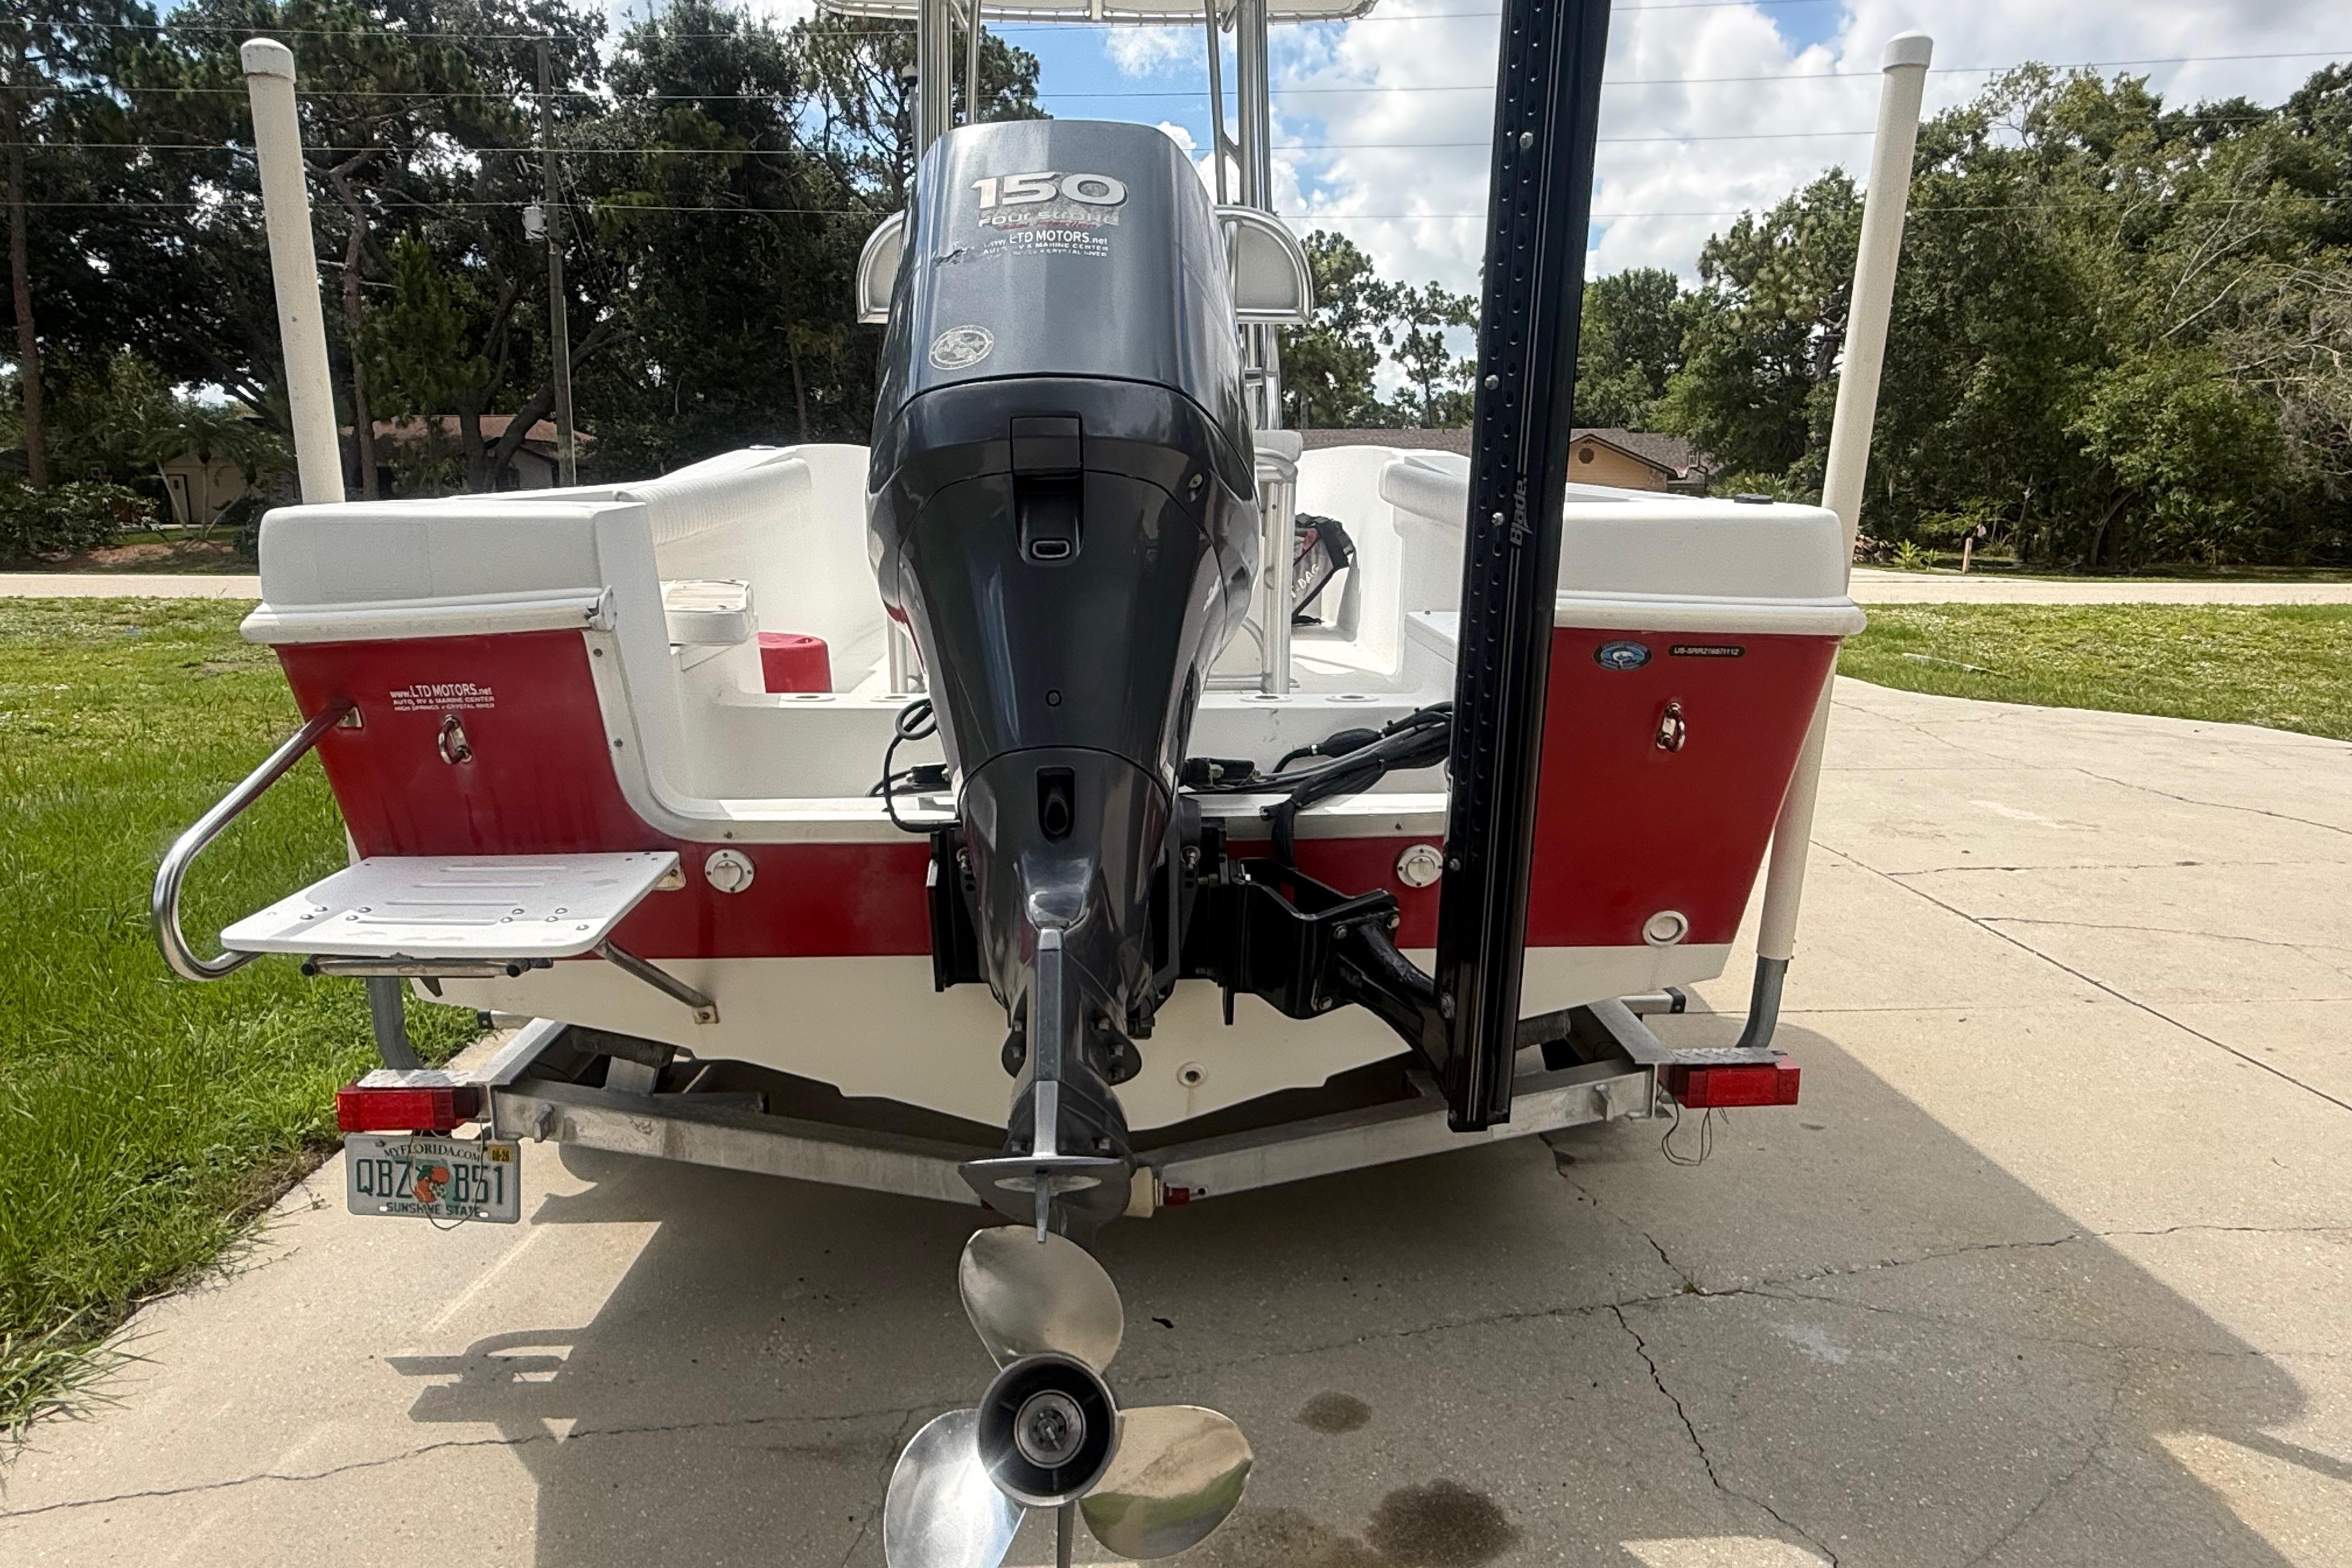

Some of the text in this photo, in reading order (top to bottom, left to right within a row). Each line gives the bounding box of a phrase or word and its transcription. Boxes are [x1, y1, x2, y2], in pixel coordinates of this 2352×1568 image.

[971, 172, 1128, 208] 150
[390, 684, 492, 698] www.LTD MOTORS.net
[384, 1143, 480, 1161] MYFLORIDA.COM
[356, 1158, 503, 1205] QBZ B51
[446, 1205, 480, 1217] STATE
